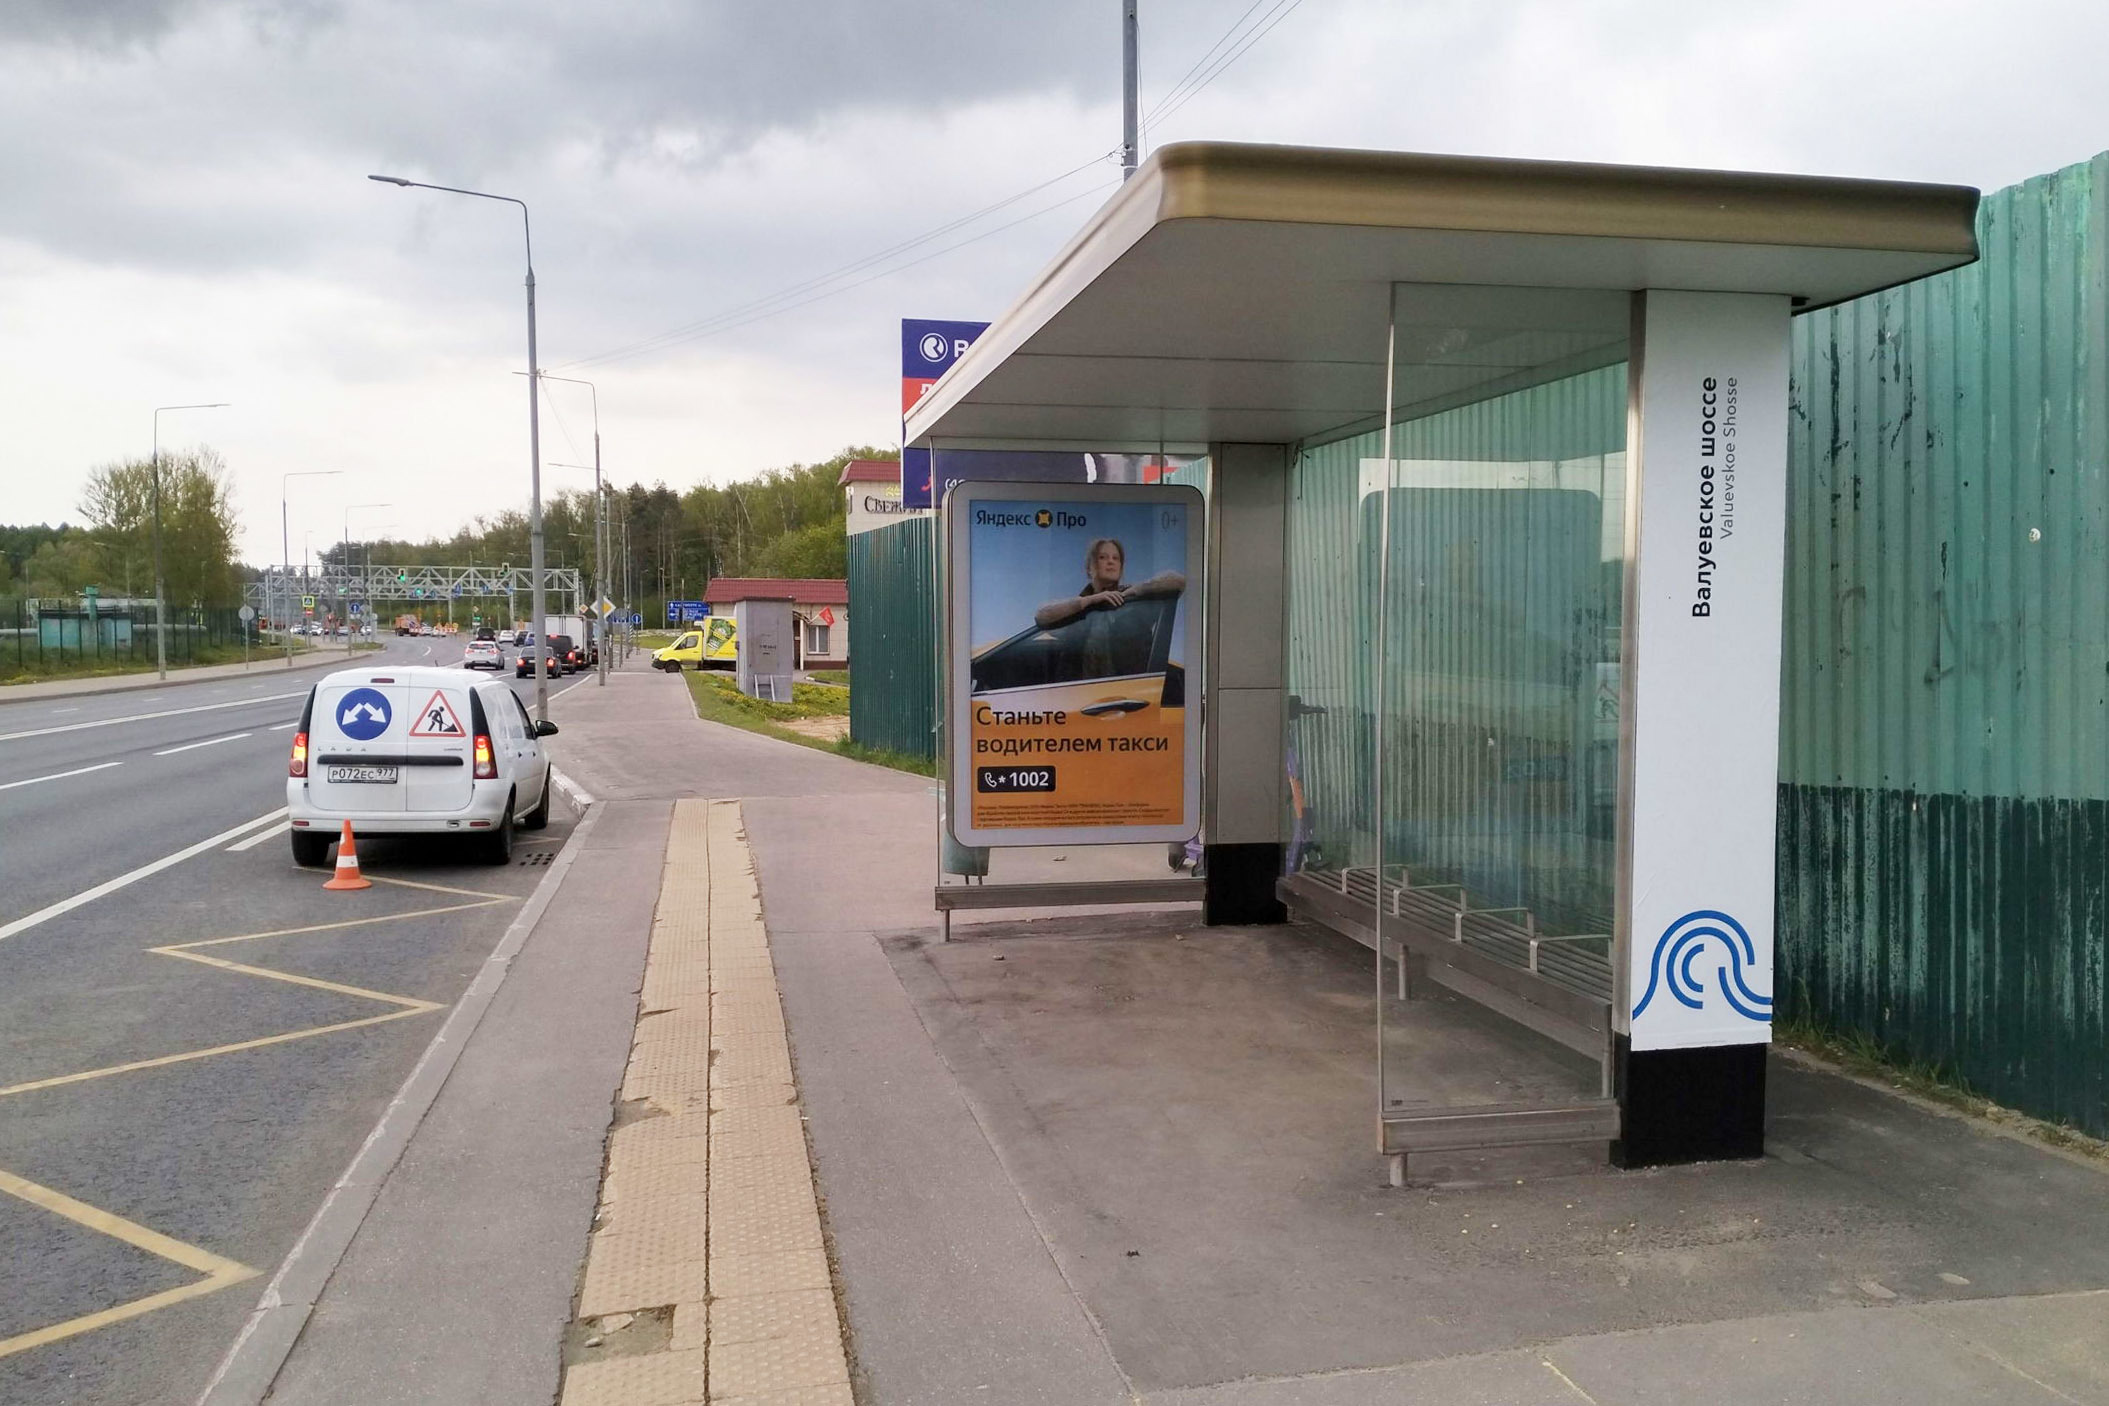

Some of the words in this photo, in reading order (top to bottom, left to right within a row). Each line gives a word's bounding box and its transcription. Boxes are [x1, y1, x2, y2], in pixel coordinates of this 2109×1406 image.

[1702, 377, 1717, 457] шоссе
[1723, 377, 1738, 437] Shosse
[1720, 442, 1736, 539] Valuevskoe
[976, 510, 1031, 527] Яндекс
[1057, 512, 1087, 529] Про
[1161, 511, 1179, 530] 0+
[1692, 465, 1716, 617] Валуевское
[976, 706, 1066, 725] Станьте
[977, 738, 1101, 756] водителем
[1108, 737, 1168, 751] такси
